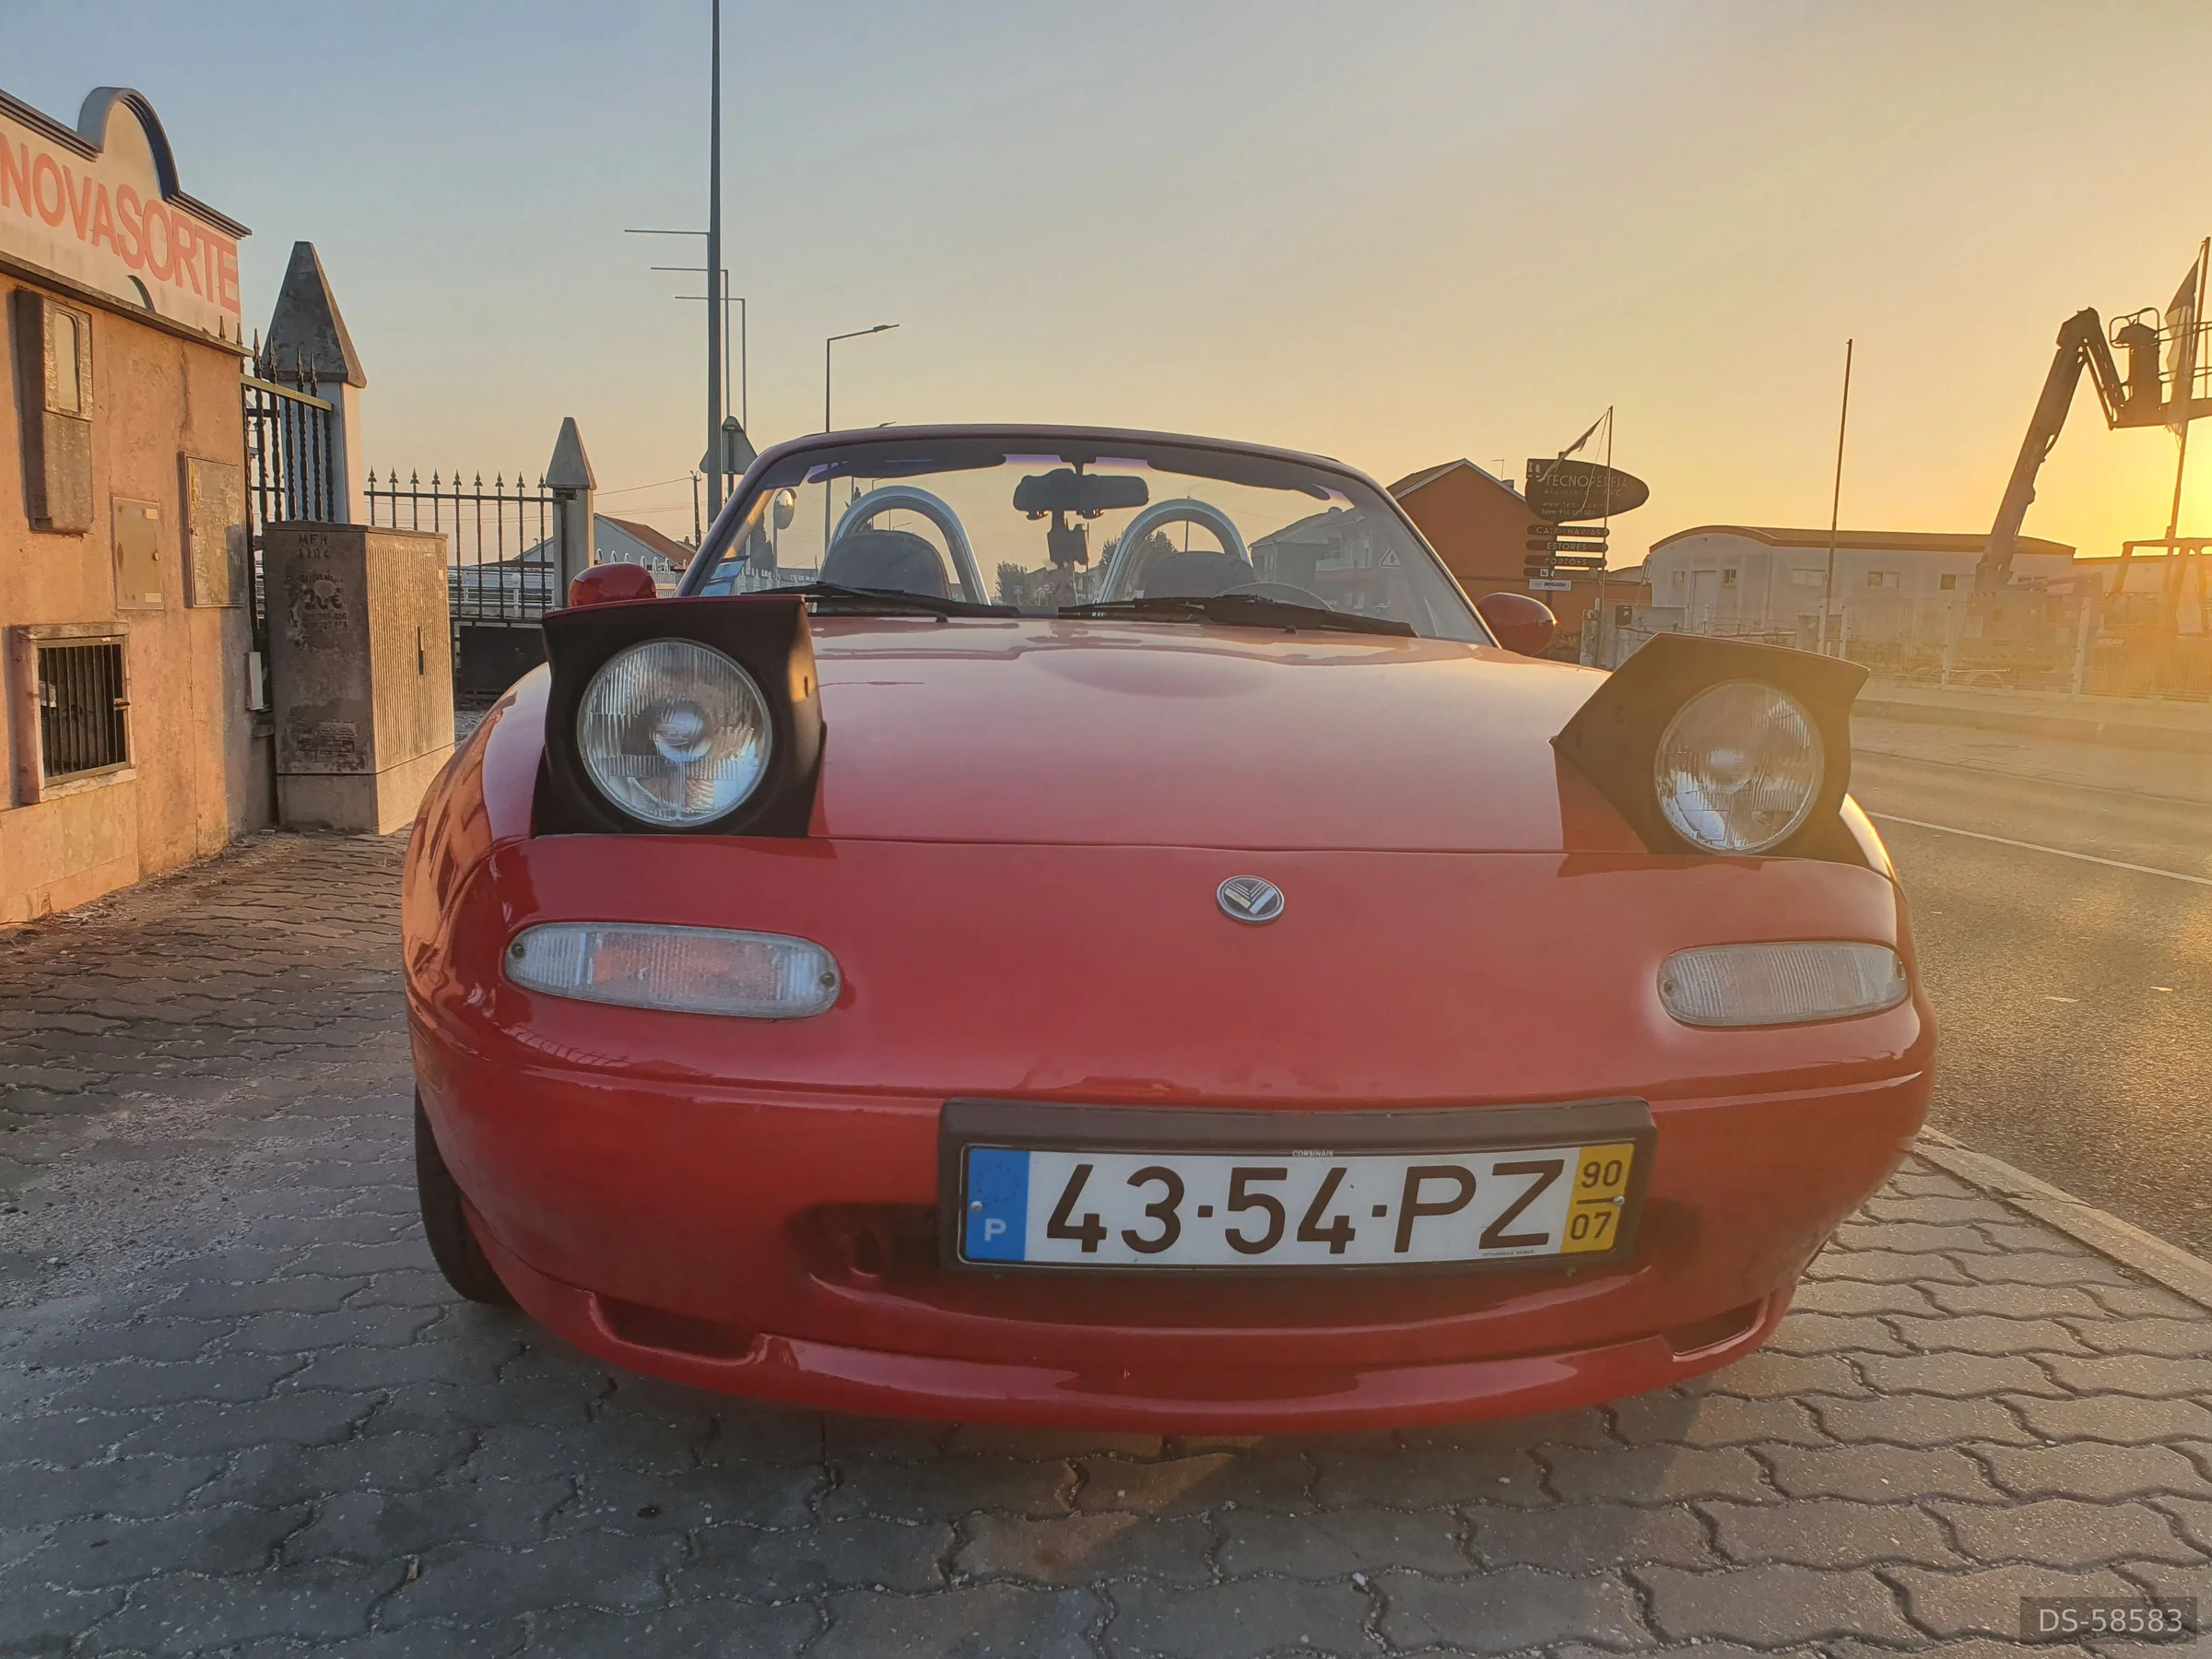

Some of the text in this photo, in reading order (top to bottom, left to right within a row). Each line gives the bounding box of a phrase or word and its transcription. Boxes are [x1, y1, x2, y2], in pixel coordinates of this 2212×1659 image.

[0, 132, 241, 315] NOVASORTE
[1547, 542, 1587, 550] ESTORES
[1581, 1159, 1623, 1188] 90
[984, 1218, 1006, 1241] P
[1570, 1211, 1612, 1241] 07
